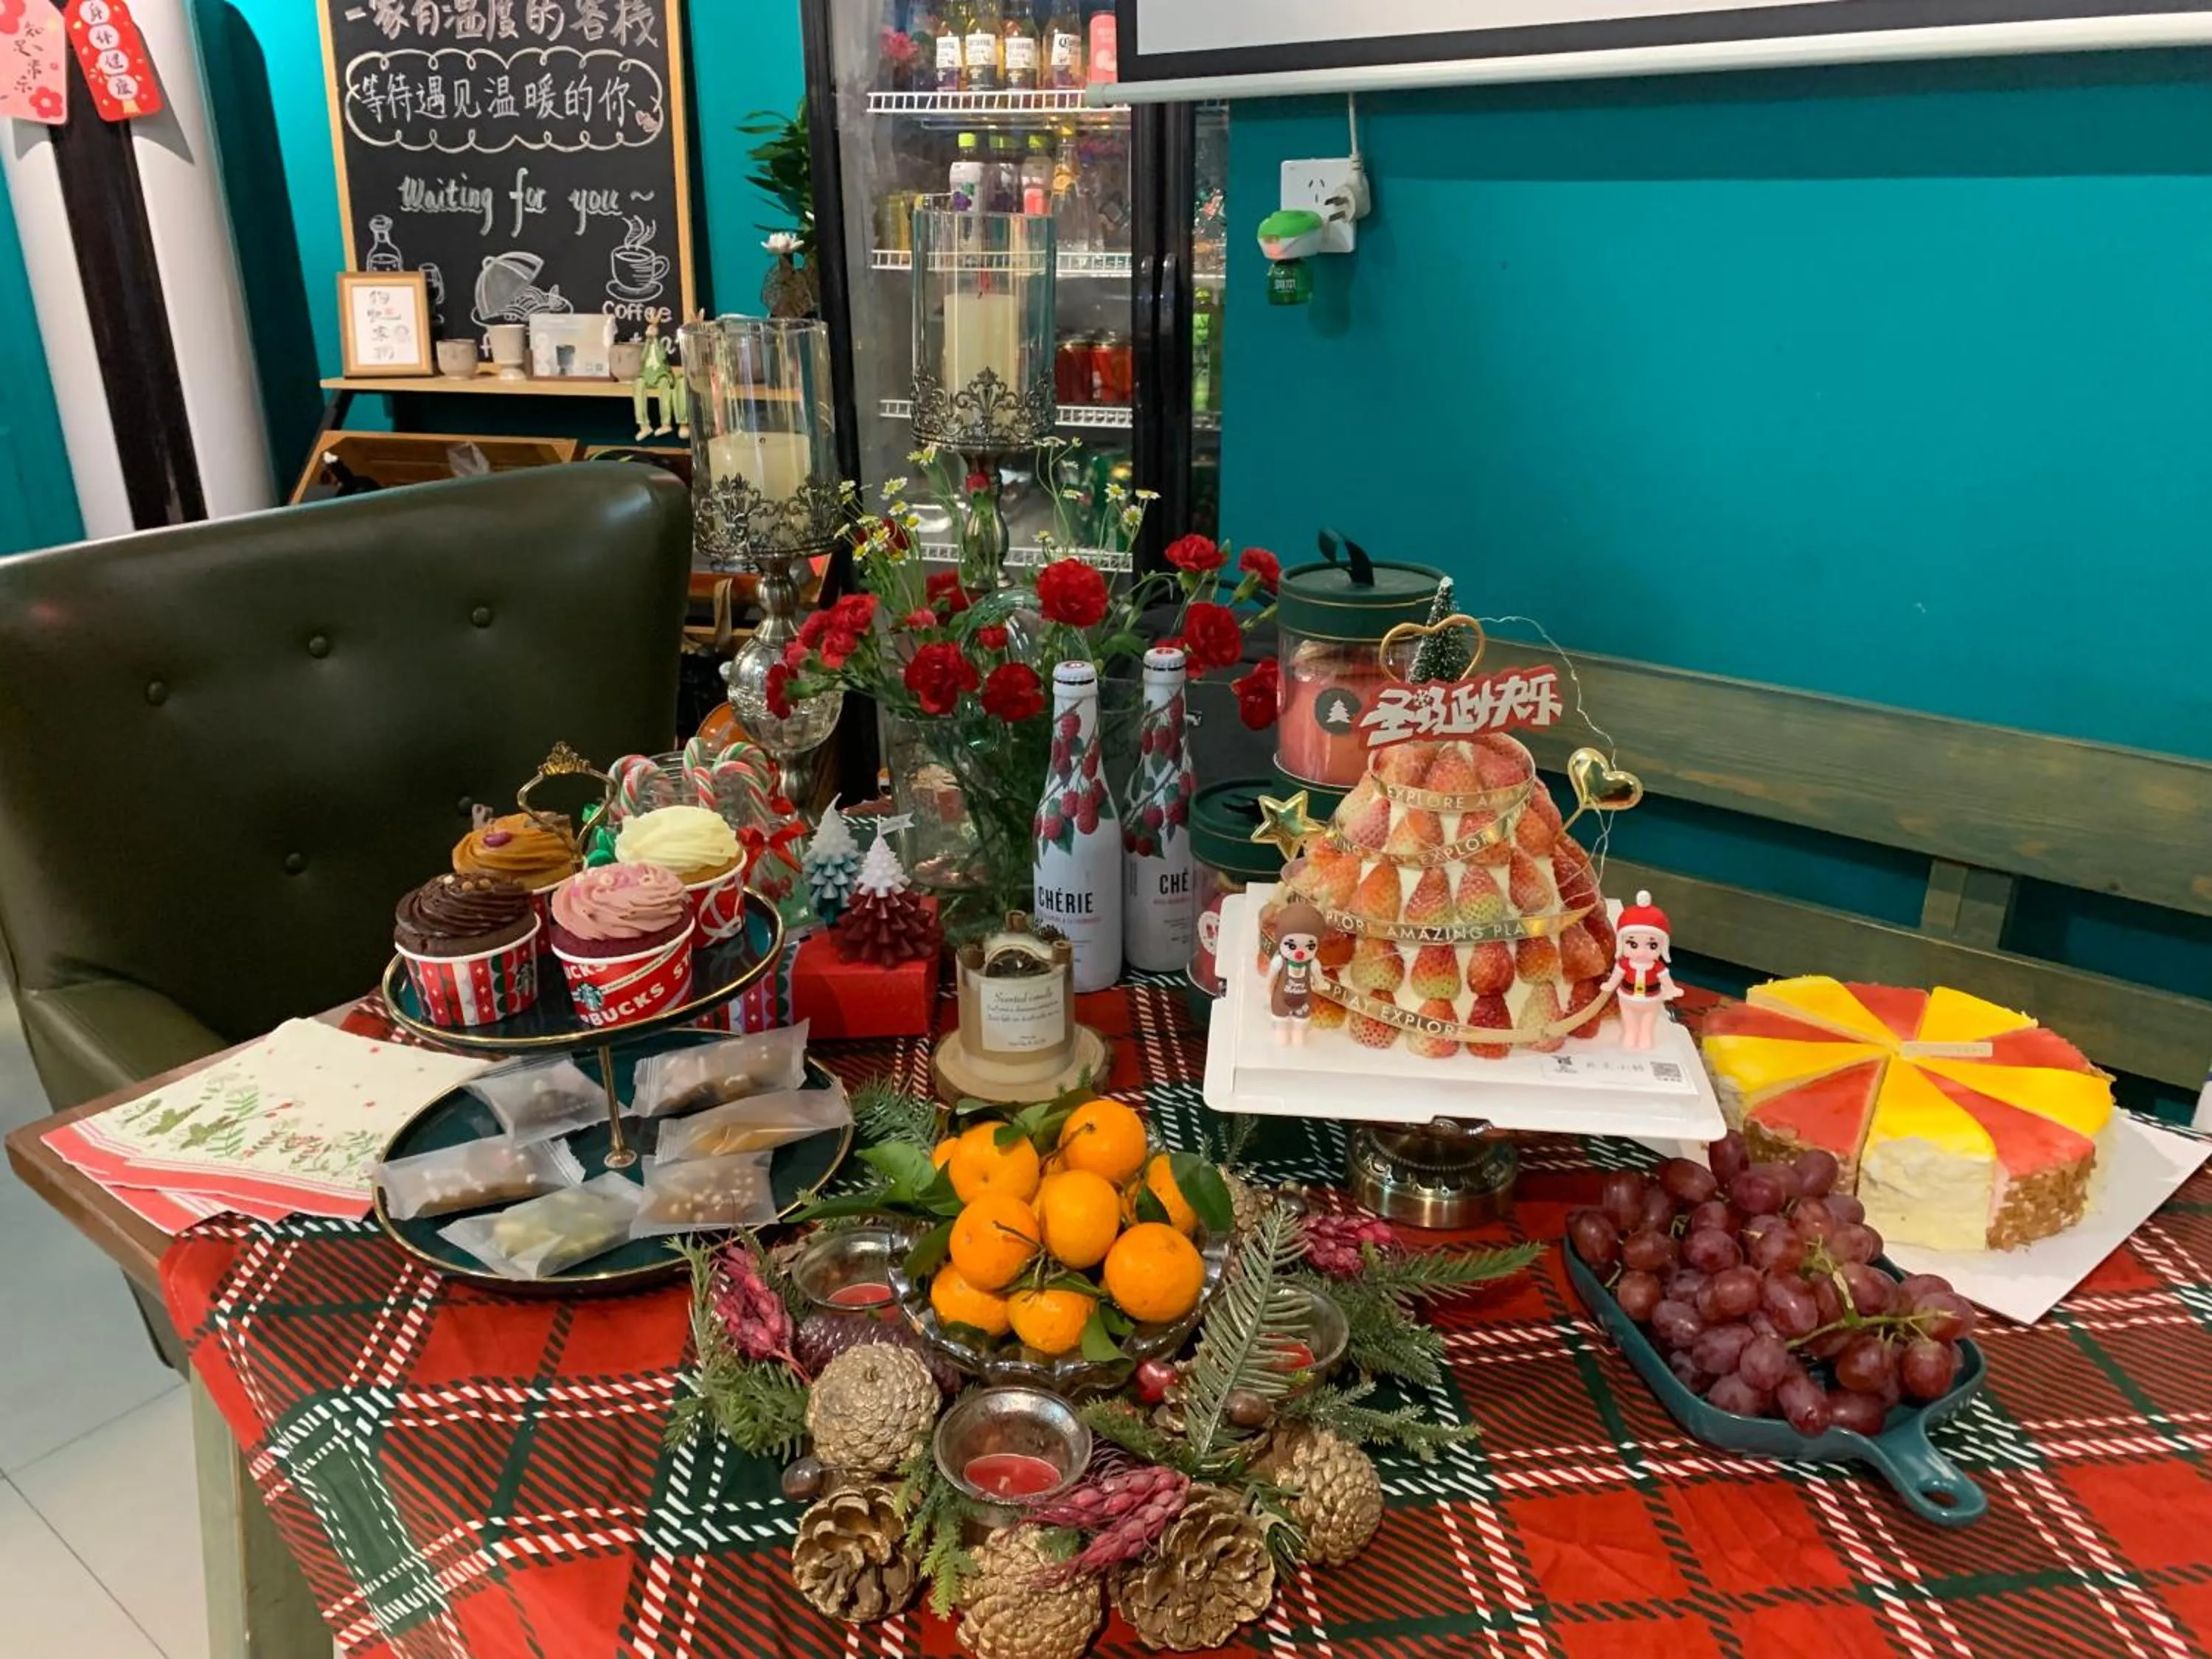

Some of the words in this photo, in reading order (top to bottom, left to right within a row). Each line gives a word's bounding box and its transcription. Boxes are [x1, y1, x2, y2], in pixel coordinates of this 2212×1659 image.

[361, 72, 636, 128] 等待遇见温暖的你
[397, 173, 493, 236] Waiting
[509, 168, 547, 237] for
[1360, 672, 1563, 747] 圣诞快乐
[1387, 785, 1464, 810] EXPLORE
[1420, 832, 1488, 865] EXPLOR
[1159, 871, 1189, 894] CHÉ
[1038, 886, 1094, 914] CHÉRIE
[1386, 925, 1484, 942] AMAZING
[1493, 922, 1526, 936] PLA
